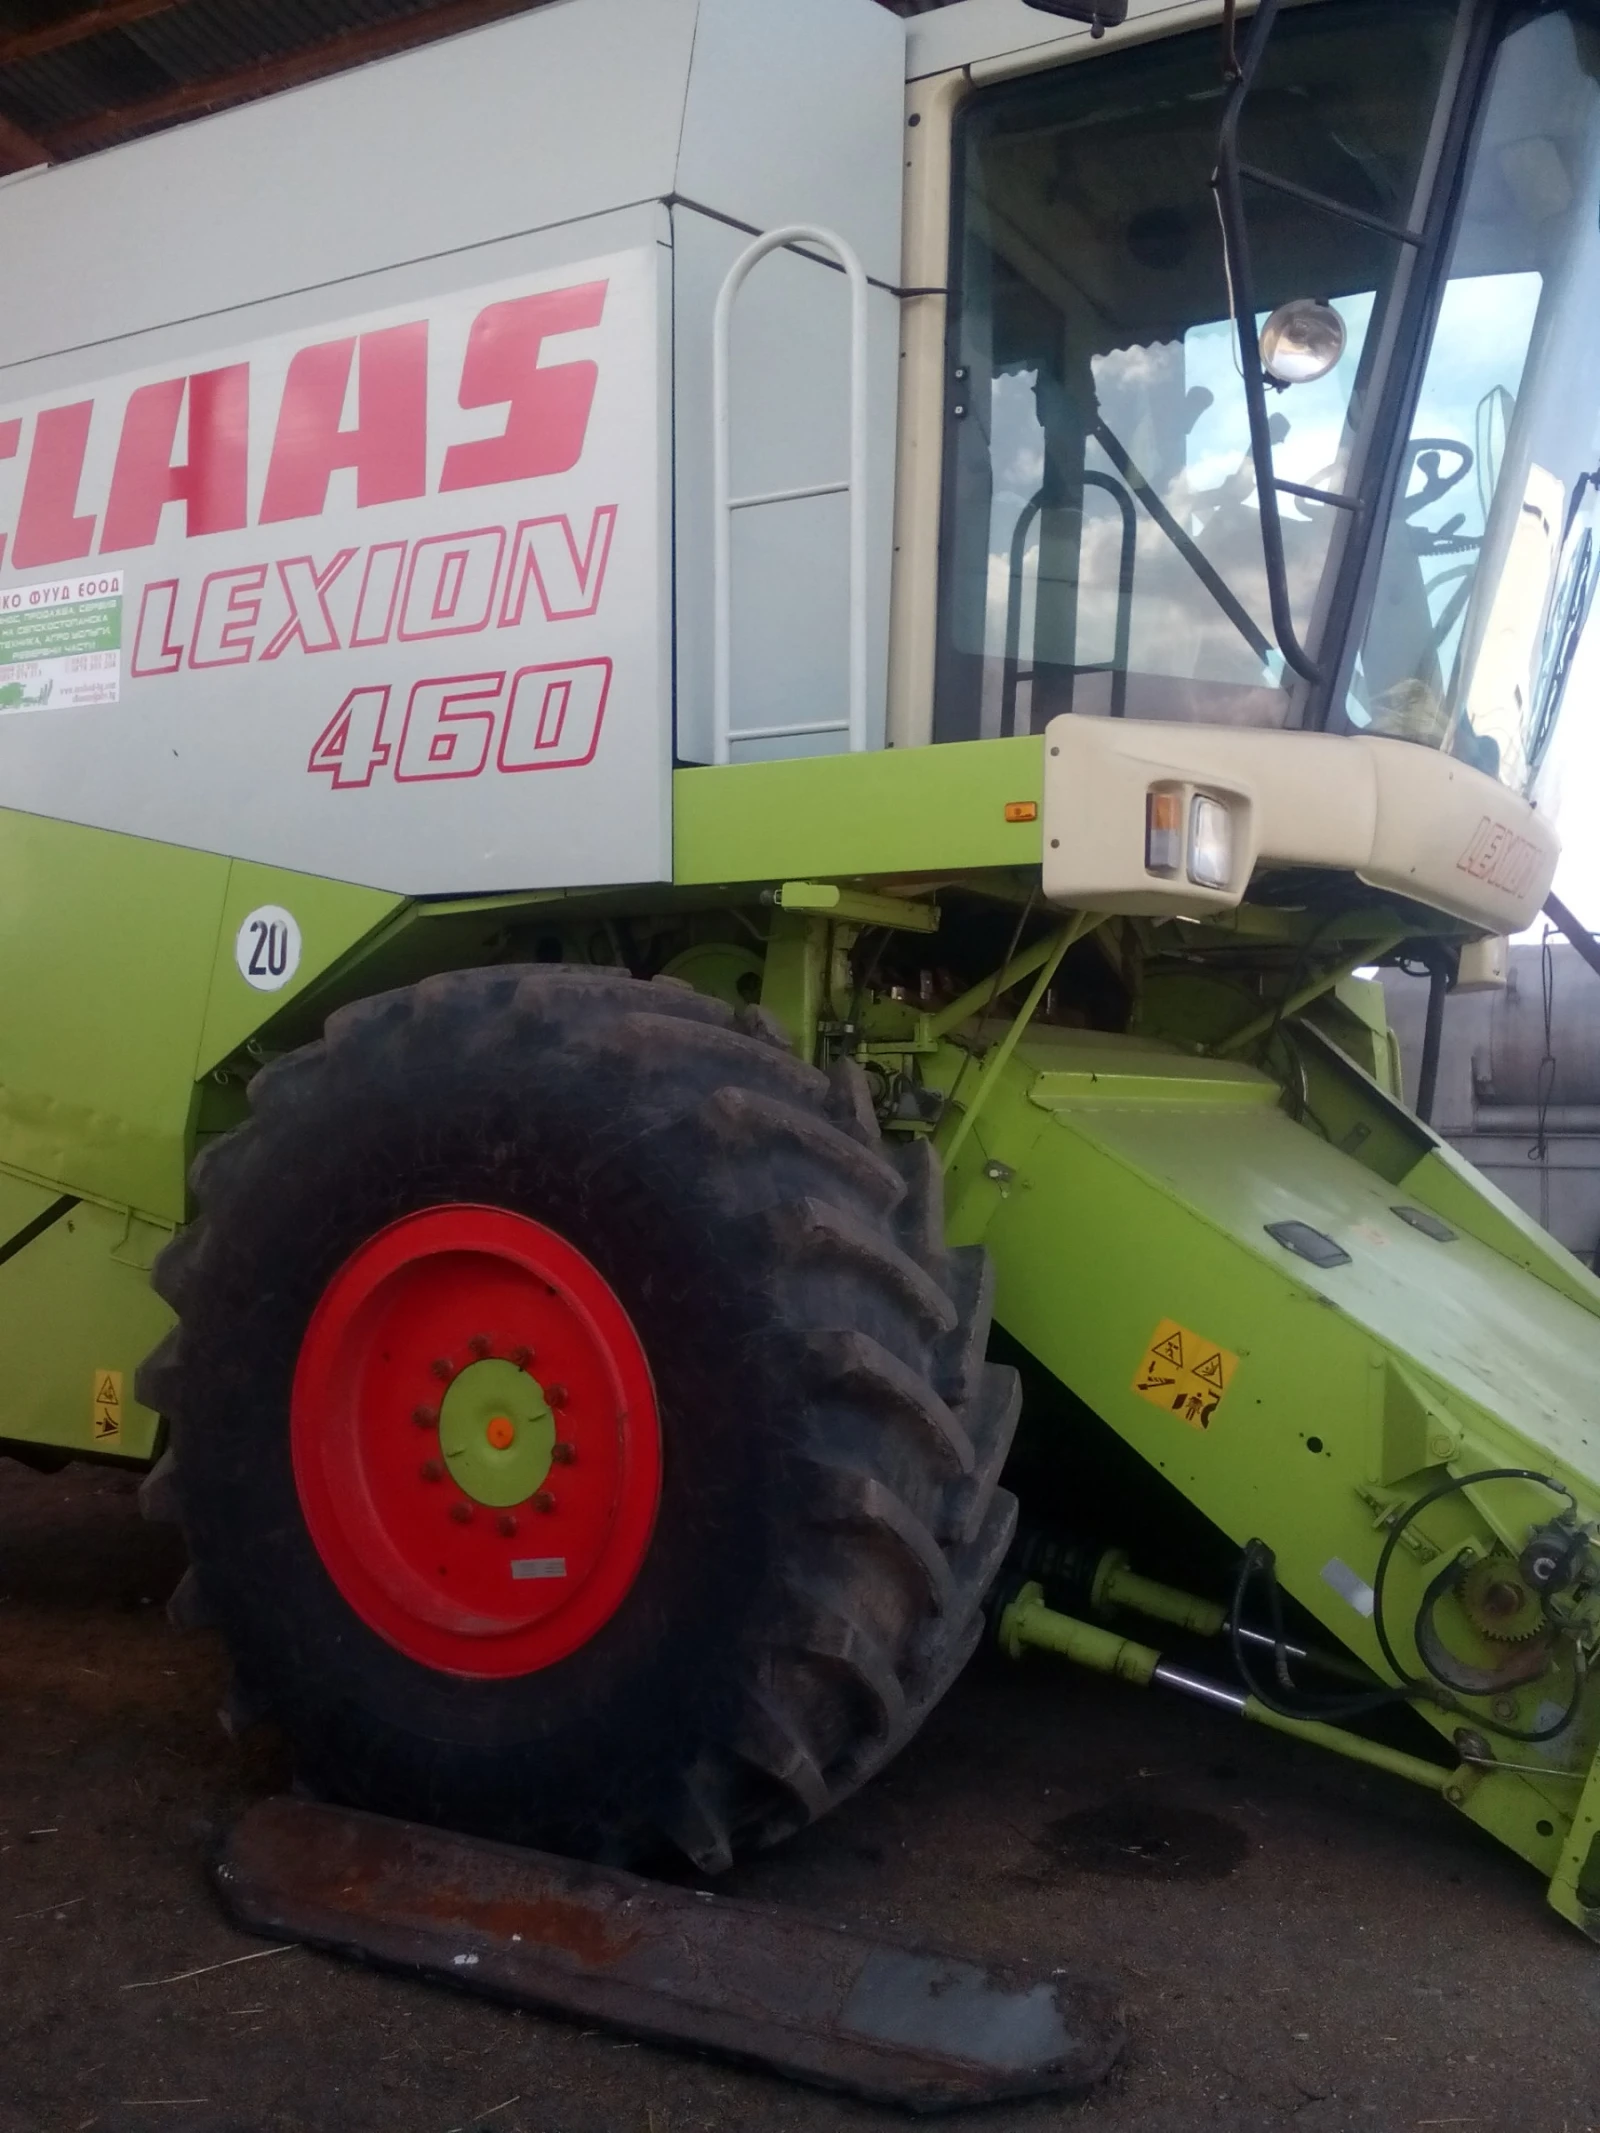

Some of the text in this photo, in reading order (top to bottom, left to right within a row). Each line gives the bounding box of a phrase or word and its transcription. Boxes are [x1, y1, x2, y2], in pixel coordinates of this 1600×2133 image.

[0, 577, 120, 609] КО ФУУД ЕООД
[131, 503, 619, 678] LEXION
[308, 656, 613, 790] 460
[248, 920, 288, 976] 20
